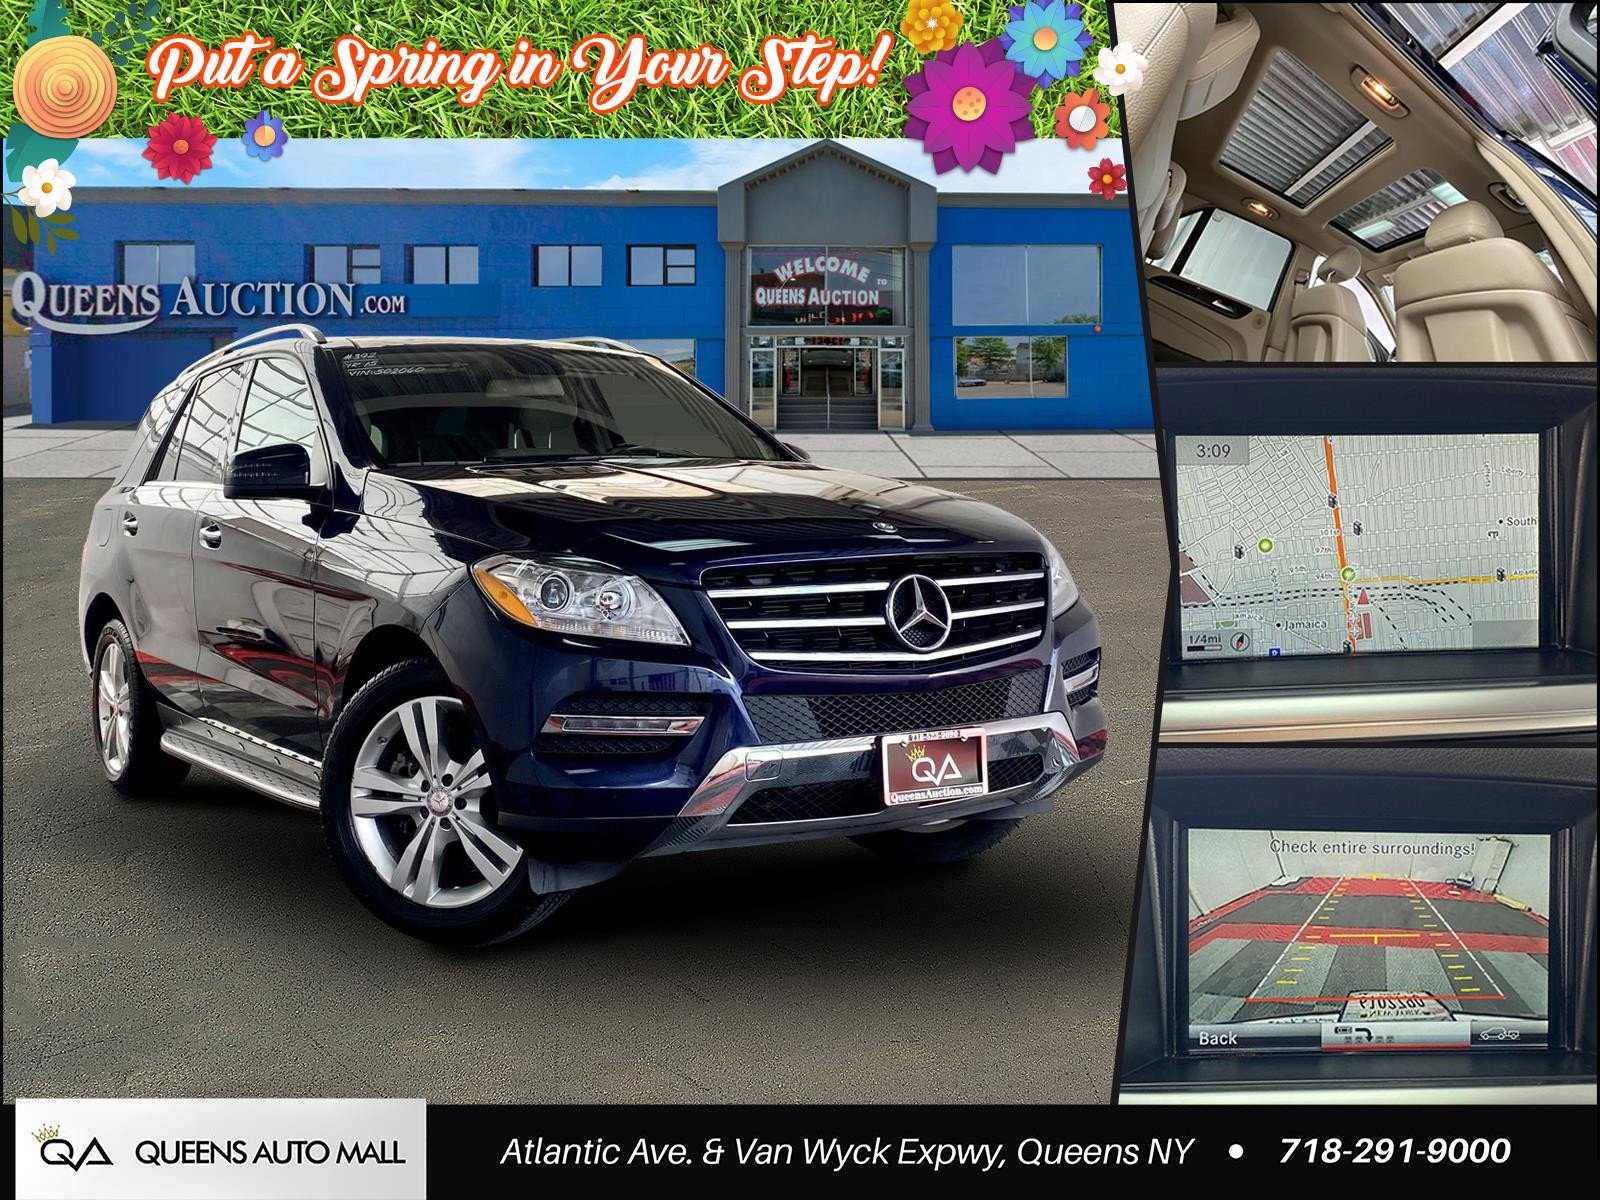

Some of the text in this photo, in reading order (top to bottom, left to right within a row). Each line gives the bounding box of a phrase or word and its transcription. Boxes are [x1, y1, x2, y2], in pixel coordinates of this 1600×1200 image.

[774, 256, 871, 283] WELCOME
[12, 270, 161, 335] QUEENS
[755, 287, 879, 306] QUEENS AUCTION
[1196, 444, 1231, 459] 3:09
[1507, 517, 1537, 526] South
[1285, 620, 1327, 631] Jamaica
[912, 753, 962, 786] QA
[890, 785, 983, 802] QueensAuction.com
[1270, 839, 1475, 858] Check entire surroundings!
[1199, 1031, 1238, 1045] Back
